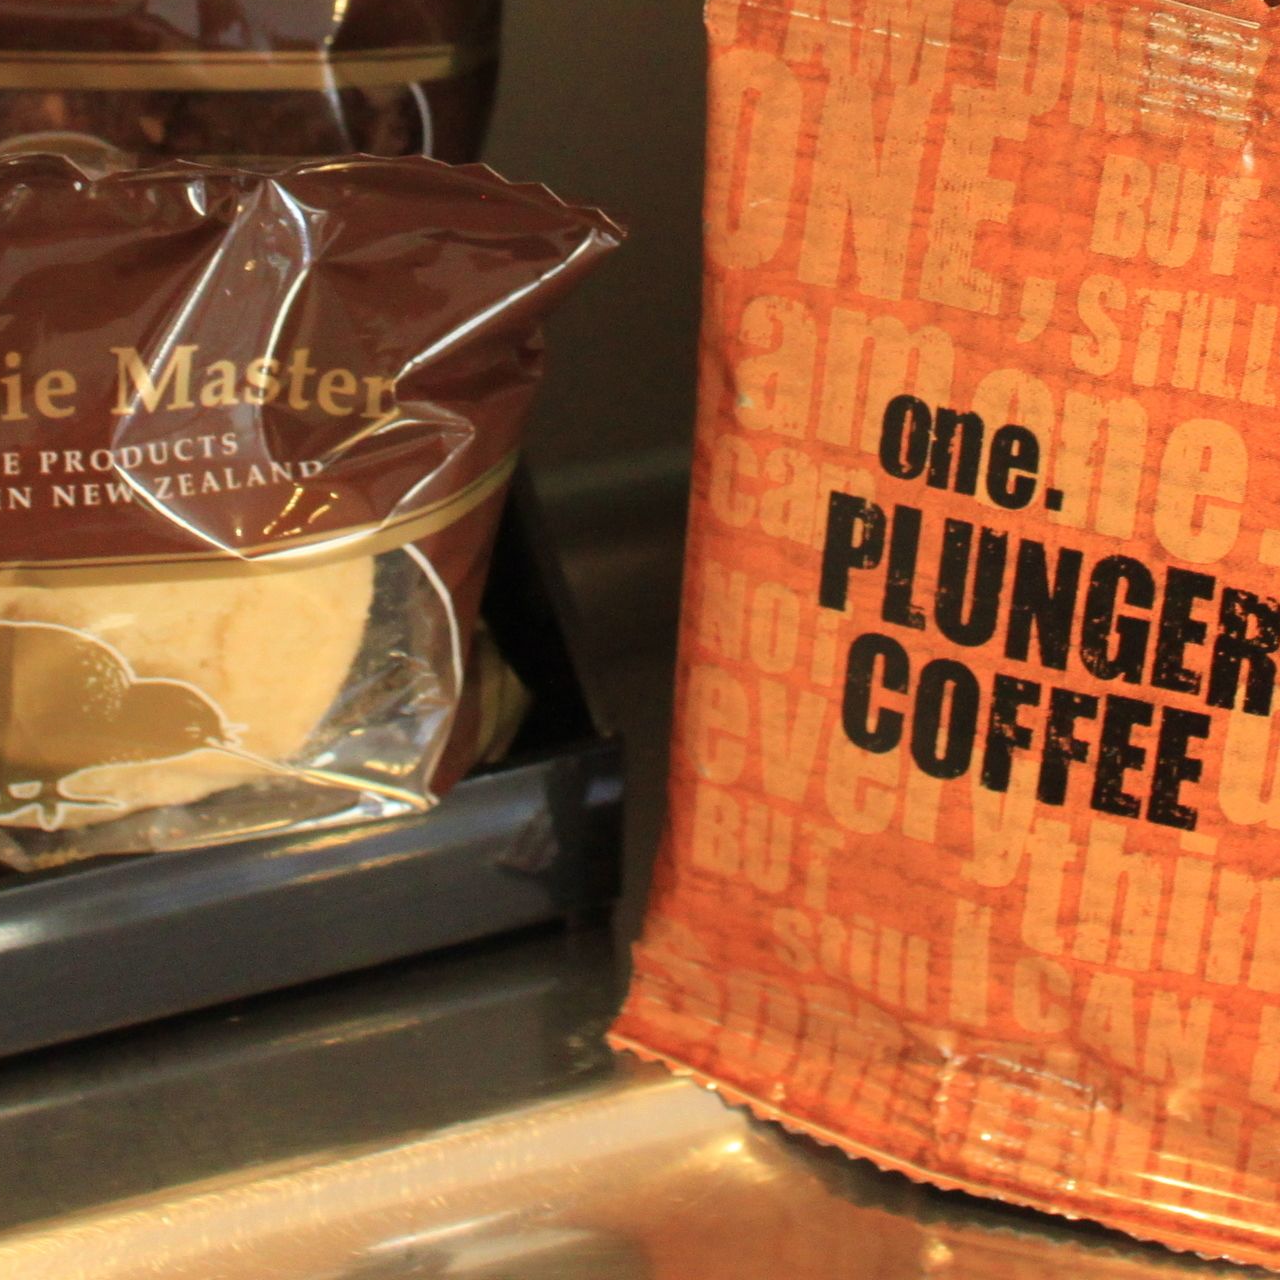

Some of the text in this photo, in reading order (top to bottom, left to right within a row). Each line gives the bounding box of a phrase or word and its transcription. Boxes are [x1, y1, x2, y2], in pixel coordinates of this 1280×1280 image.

[1090, 153, 1263, 277] BUT
[110, 344, 404, 422] Master
[1070, 274, 1279, 407] STILL
[39, 432, 240, 475] PRODUCTS
[53, 482, 138, 508] NEW
[154, 459, 326, 501] ZEALAND
[878, 393, 1064, 512] one.
[841, 632, 1212, 832] COFFEE
[691, 784, 846, 911] BUT
[1013, 956, 1215, 1084] CAN
